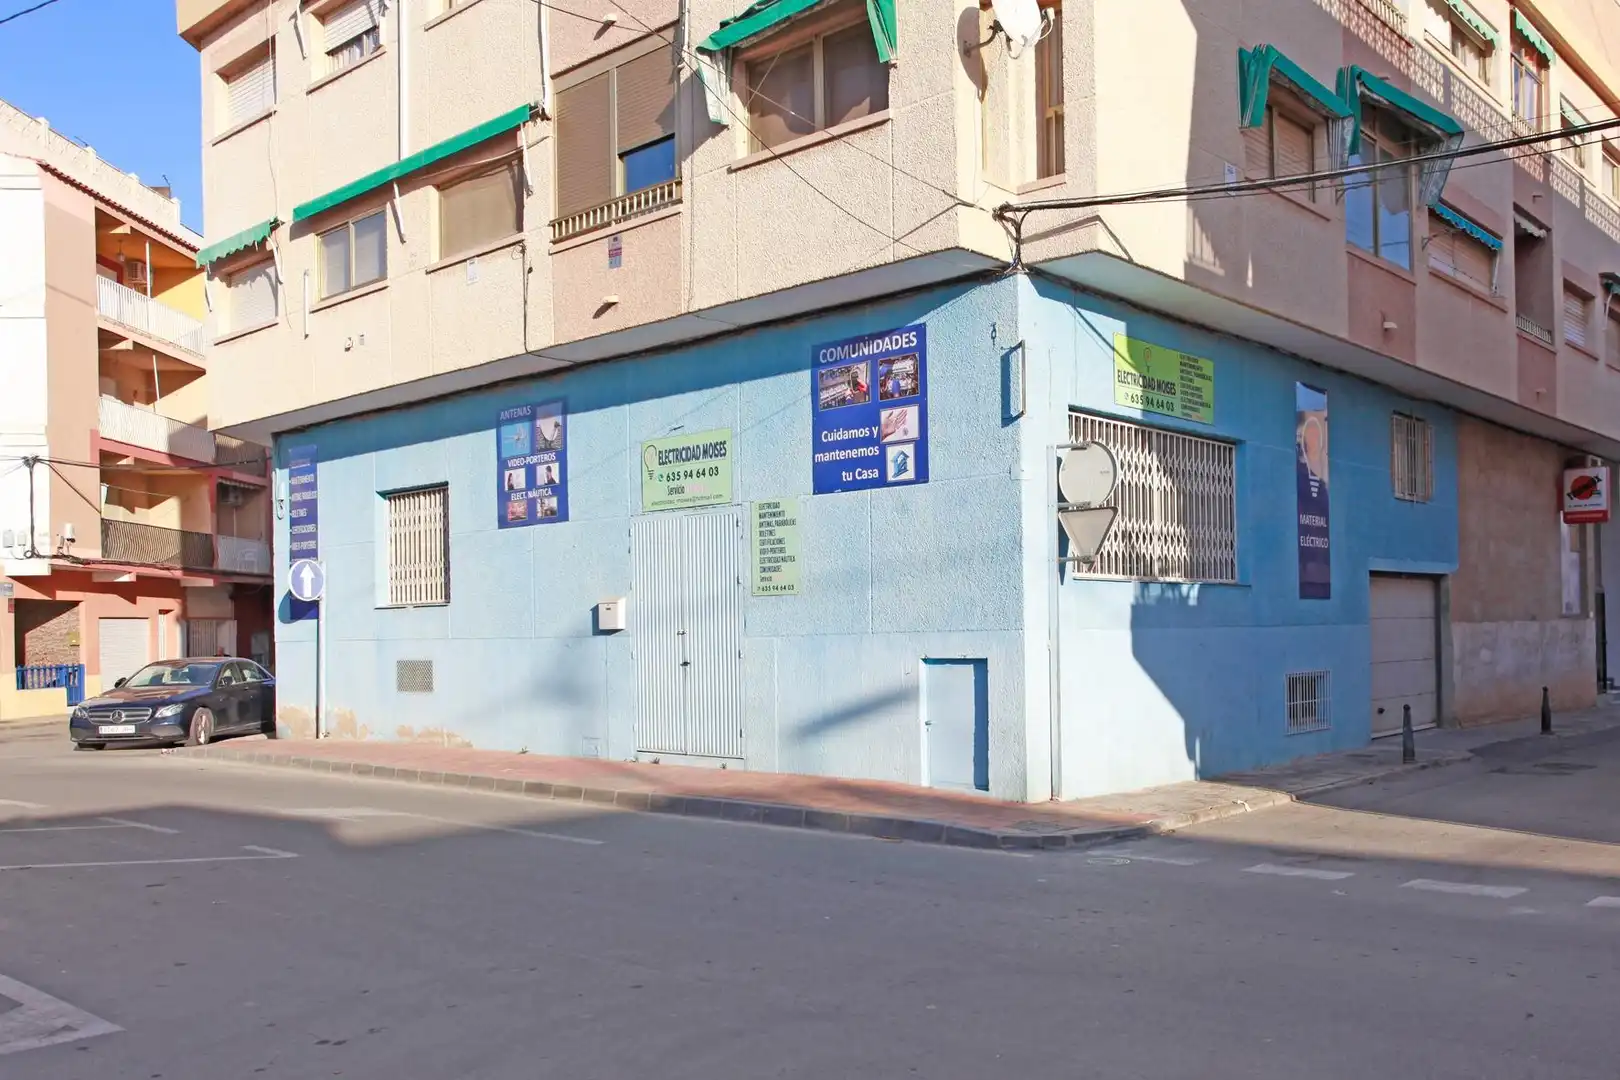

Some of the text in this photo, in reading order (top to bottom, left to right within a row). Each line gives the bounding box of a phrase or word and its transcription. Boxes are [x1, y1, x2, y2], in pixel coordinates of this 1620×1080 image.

[1117, 369, 1156, 391] ELECTRICIDAD
[1156, 378, 1176, 396] MOISES
[1130, 392, 1144, 405] 635
[1145, 396, 1155, 408] 94
[1156, 398, 1165, 410] 64
[1165, 400, 1175, 412] 03
[500, 405, 532, 421] ANTENAS
[821, 425, 879, 443] Cuidamos y
[507, 452, 556, 468] VIDEO-PORTEROS
[658, 440, 727, 467] ELECTRICIDAD MOISES
[815, 445, 880, 464] mantenemos
[666, 466, 719, 483] 635 94 64 03
[841, 467, 879, 482] tu Casa
[510, 491, 527, 501] ELECT.
[667, 484, 685, 496] Servicio
[1300, 514, 1327, 528] MATERIAL
[1300, 534, 1329, 549] ELÉCTRICO
